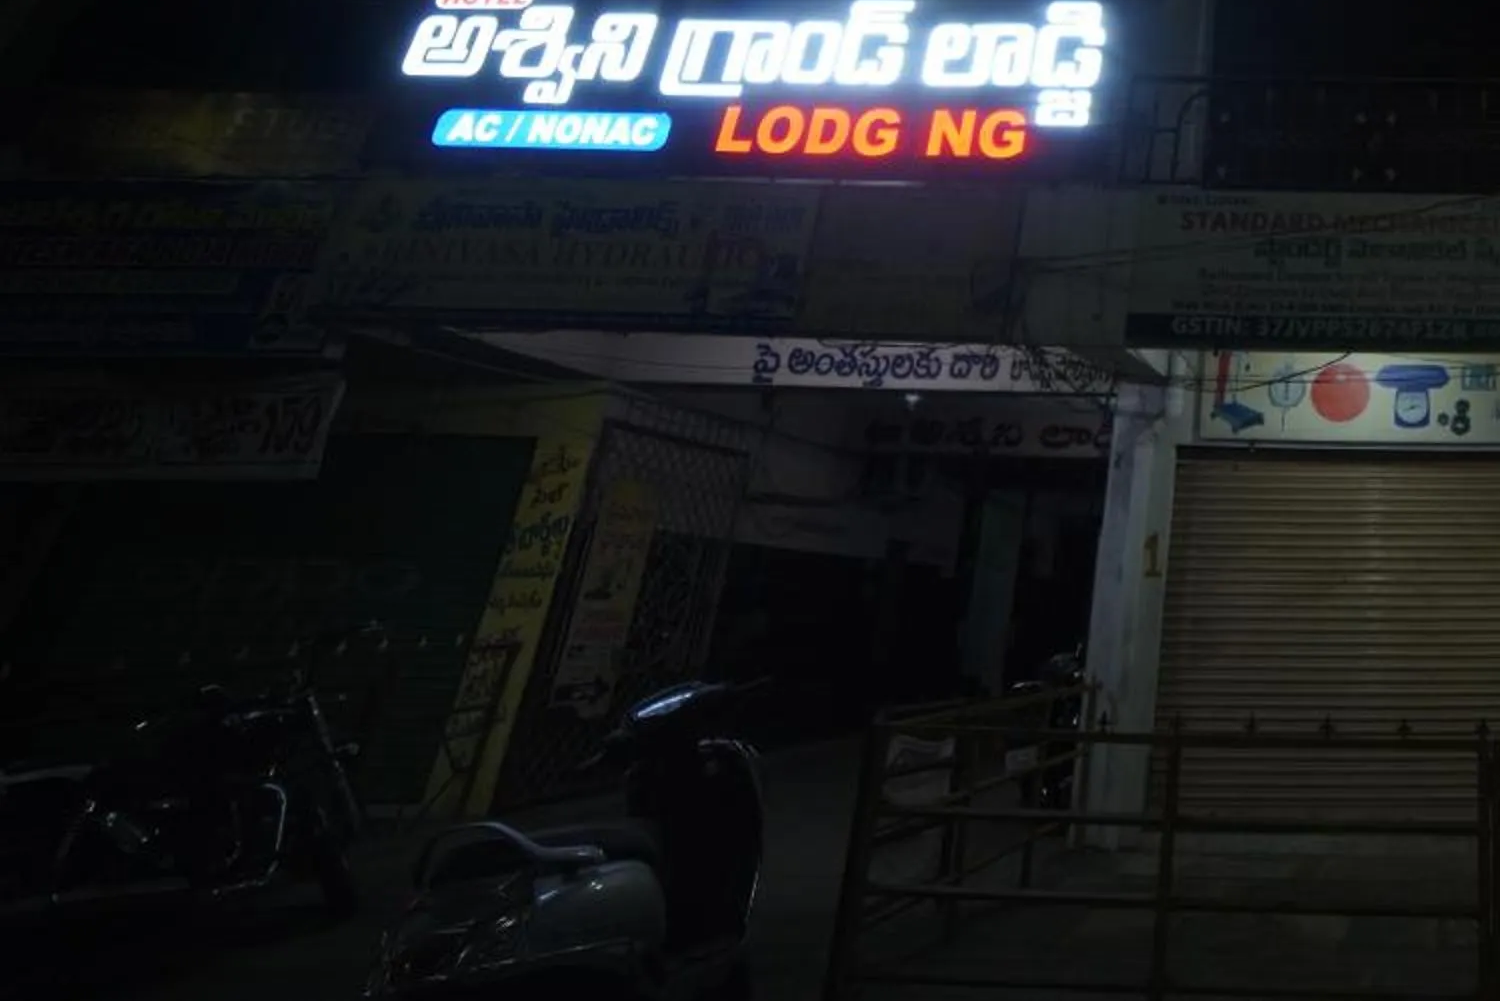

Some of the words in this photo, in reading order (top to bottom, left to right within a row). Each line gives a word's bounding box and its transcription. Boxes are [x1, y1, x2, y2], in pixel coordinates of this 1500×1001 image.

[401, 5, 658, 105] అశ్విని
[446, 113, 501, 143] AC
[526, 113, 659, 145] NONAC
[1180, 210, 1320, 234] STANDARD
